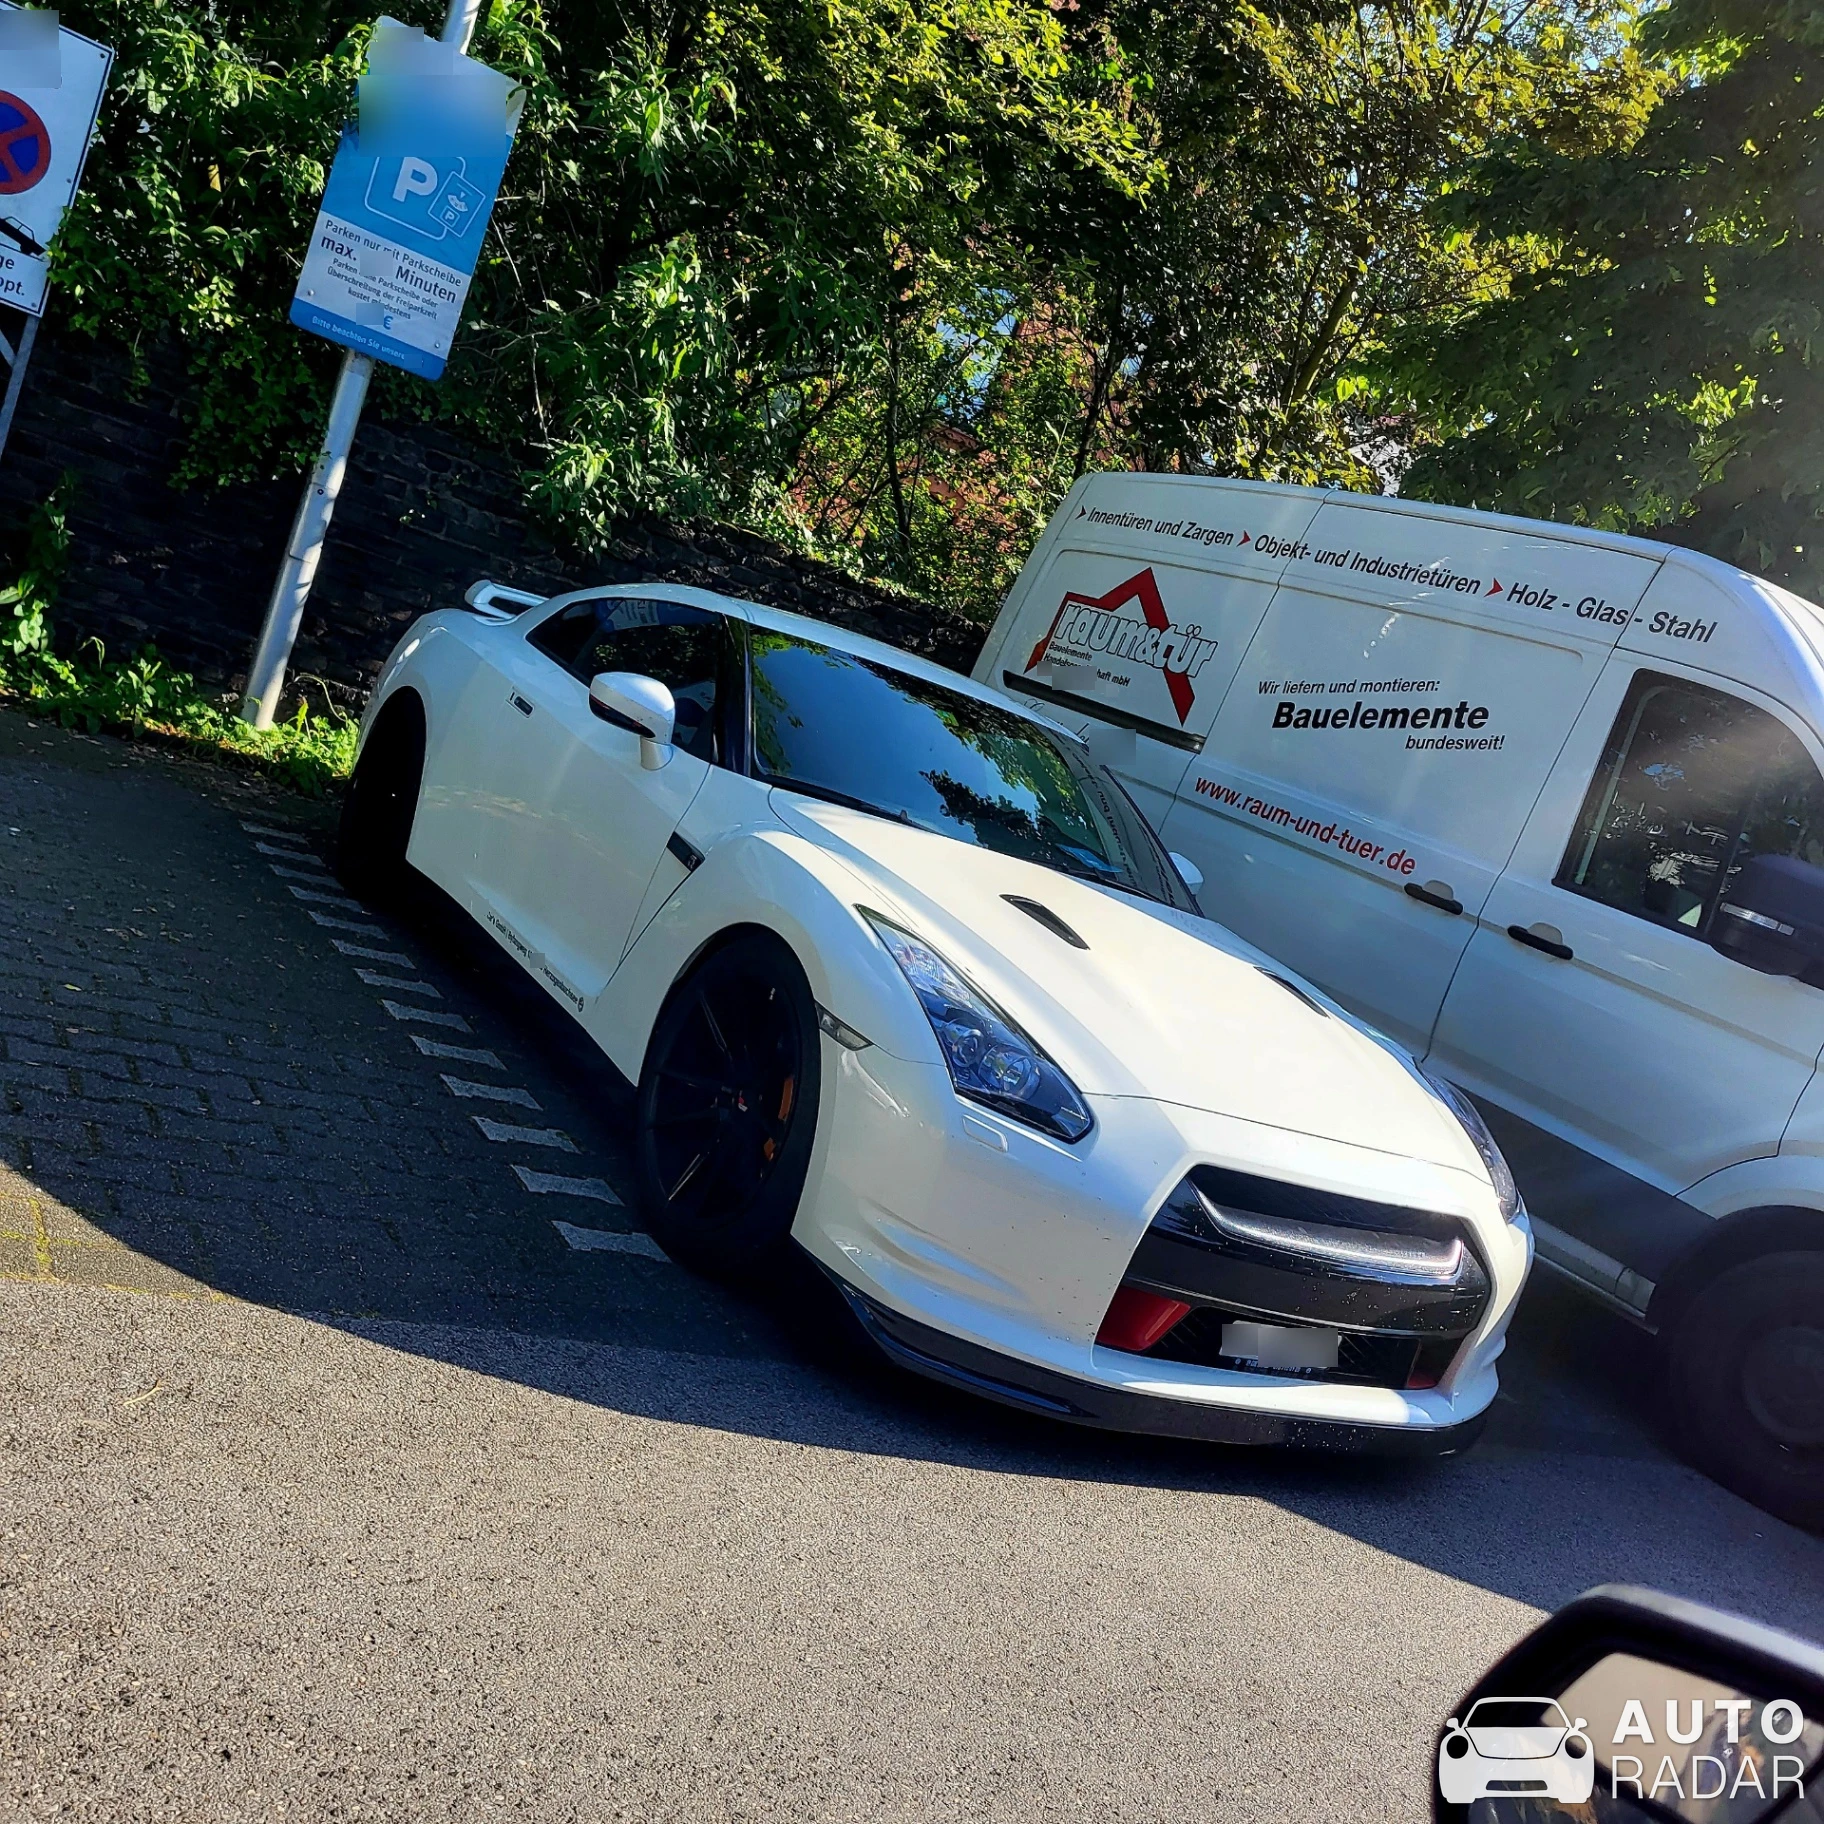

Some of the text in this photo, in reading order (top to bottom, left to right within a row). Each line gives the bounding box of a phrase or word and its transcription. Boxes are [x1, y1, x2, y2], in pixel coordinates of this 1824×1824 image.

[321, 236, 457, 304] max. Minuten
[325, 219, 361, 243] Parken
[364, 238, 381, 252] nur
[402, 253, 462, 287] Parkscheibe
[327, 265, 438, 320] Überschreitung der Freiparkzeit
[333, 258, 358, 274] Parken
[378, 277, 420, 301] Parkscheibe
[421, 296, 438, 308] oder
[348, 287, 370, 303] kostet
[312, 315, 331, 330] Bitte
[332, 323, 366, 344] beachten
[367, 338, 380, 350] Sie
[1087, 506, 1153, 533] Innentüren
[1154, 518, 1181, 537] und
[1181, 521, 1234, 547] Zargen
[1254, 534, 1311, 560] Objekt-
[1314, 548, 1349, 568] und
[1350, 551, 1481, 596] Industrietüren
[1506, 582, 1559, 611] Holz
[1576, 597, 1630, 626] Glas
[1648, 611, 1718, 643] Stahl
[1049, 641, 1093, 662] Bauelemente
[1112, 675, 1131, 687] mbH
[1258, 678, 1440, 694] Wir liefern und montieren:
[1272, 701, 1490, 729] Bauelemente
[1405, 735, 1506, 750] bundesweit!
[1195, 776, 1416, 876] www.raum-und-tuer.de
